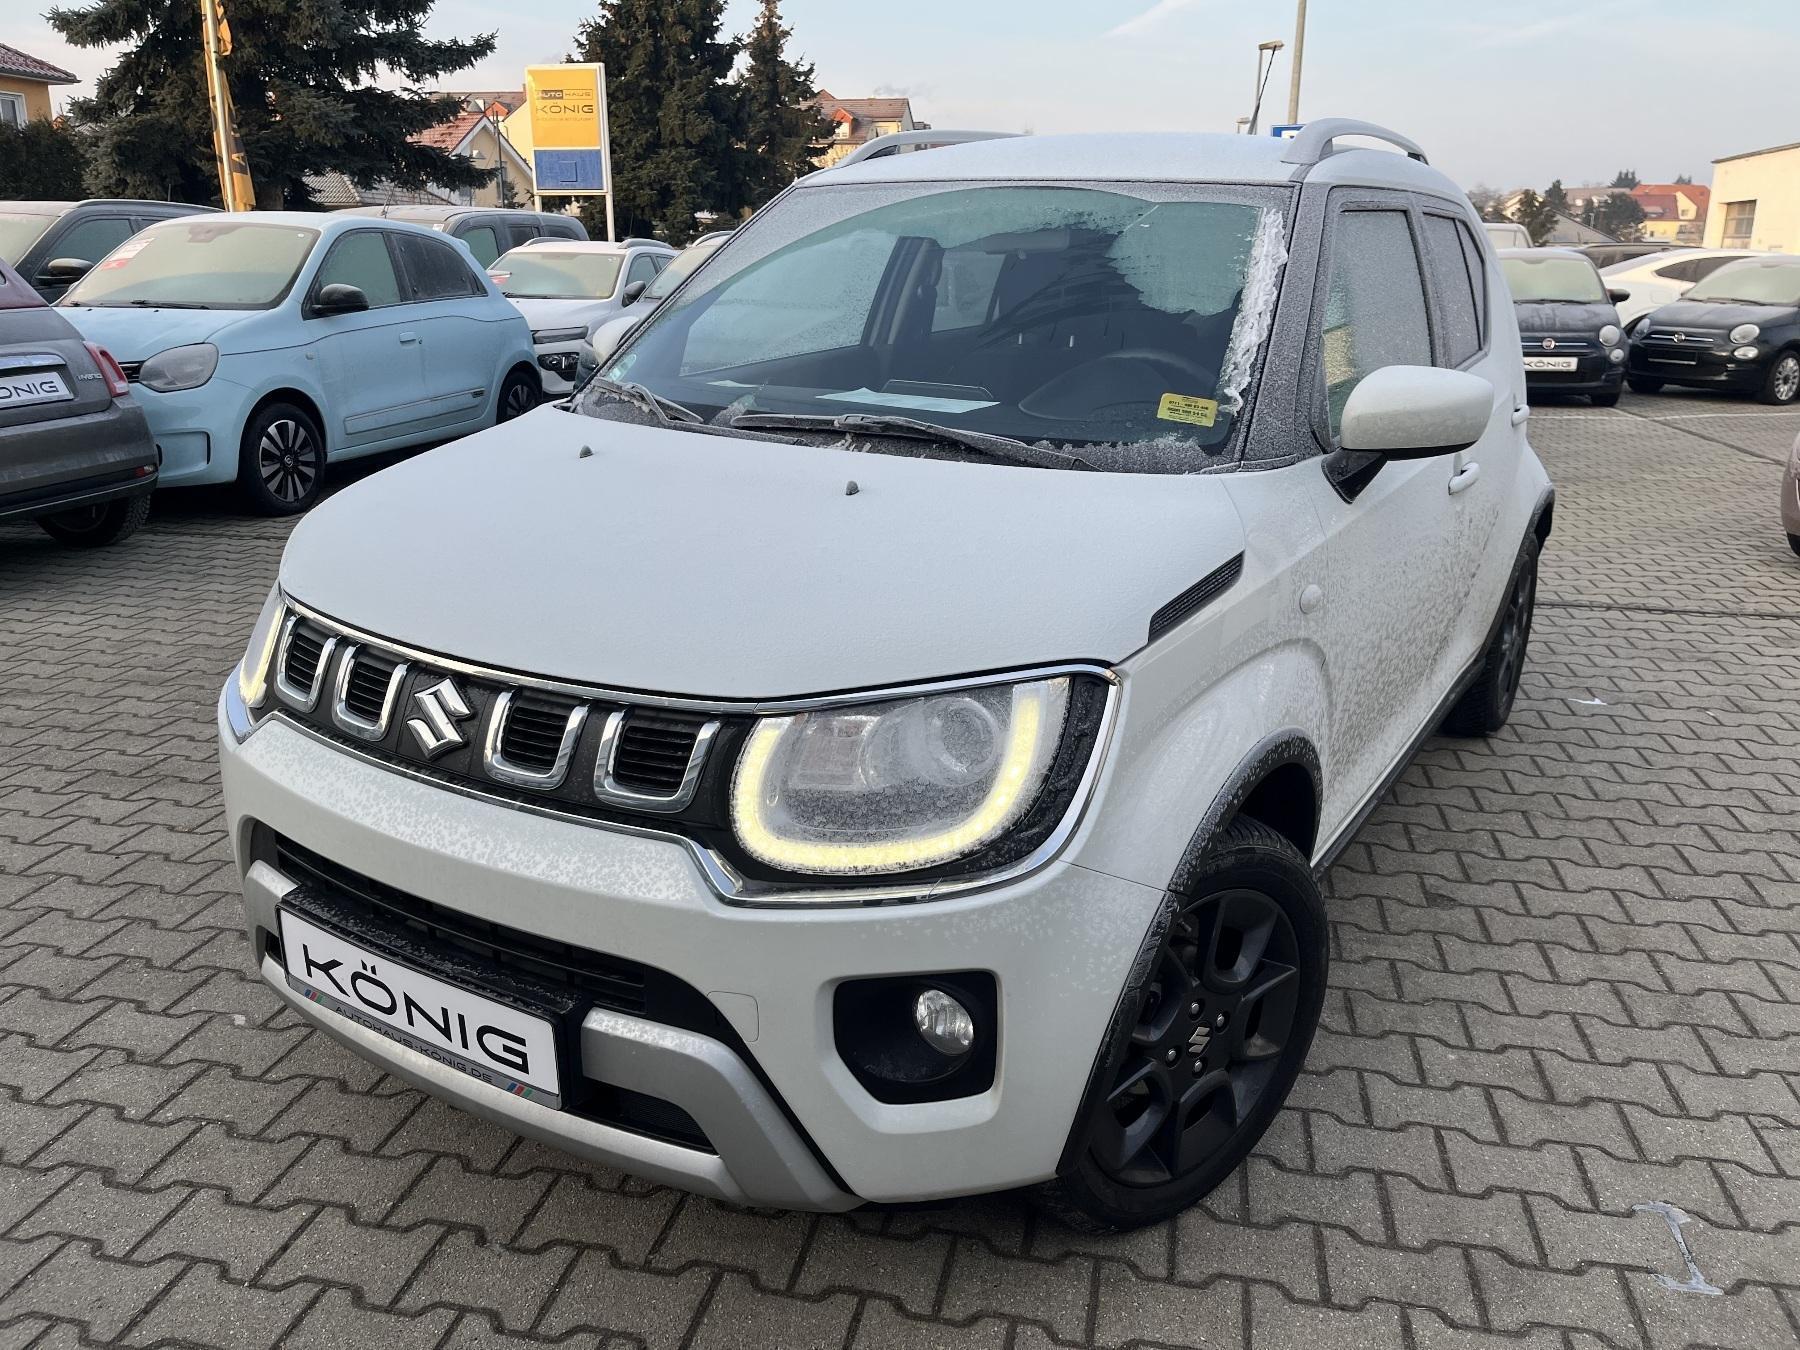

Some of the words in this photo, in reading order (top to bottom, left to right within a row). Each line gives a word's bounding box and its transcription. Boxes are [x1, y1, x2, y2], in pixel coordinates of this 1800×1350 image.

[535, 102, 594, 114] KÖNIG
[1523, 360, 1572, 368] KÖNIG
[302, 943, 530, 1075] KÖNIG
